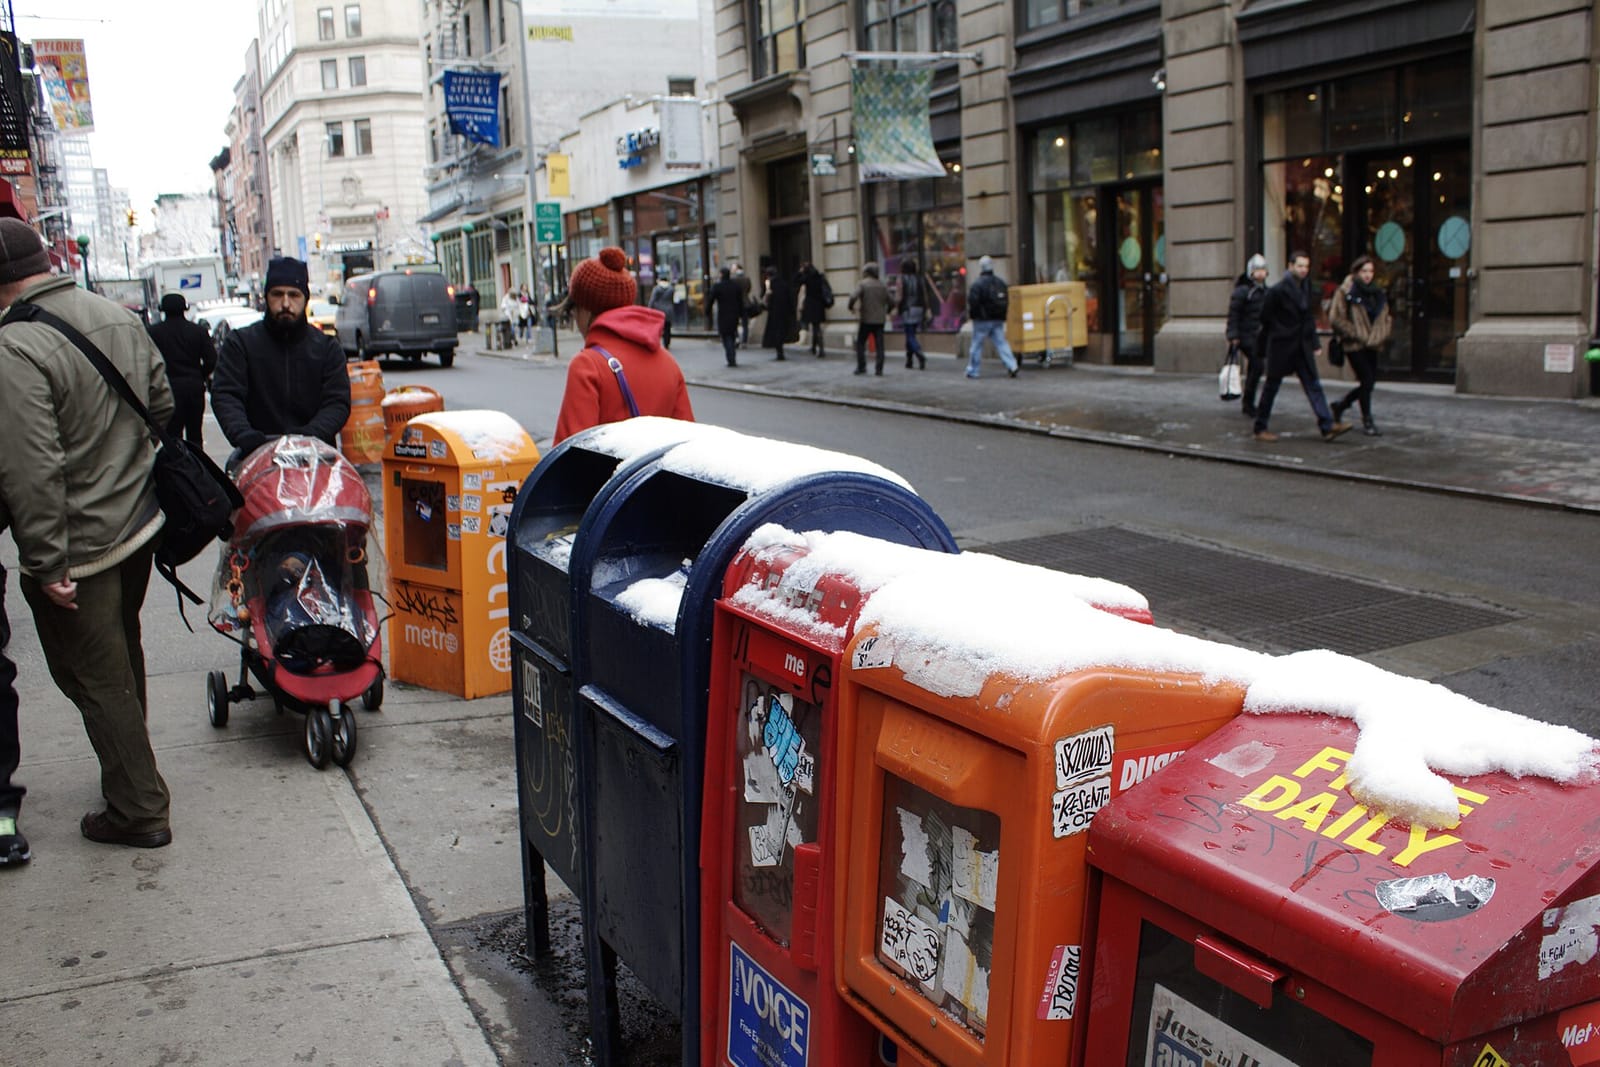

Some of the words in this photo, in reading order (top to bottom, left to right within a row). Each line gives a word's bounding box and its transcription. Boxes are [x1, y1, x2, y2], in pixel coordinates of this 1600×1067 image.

[450, 85, 491, 95] STREET
[452, 76, 490, 85] SPRING
[447, 95, 494, 105] NATURAL
[784, 652, 805, 677] me
[1238, 775, 1463, 867] DAILY
[1042, 960, 1058, 1002] HELLO
[739, 957, 805, 1057] VOICE
[1156, 1008, 1213, 1057] Jazz
[1561, 1022, 1592, 1048] Met
